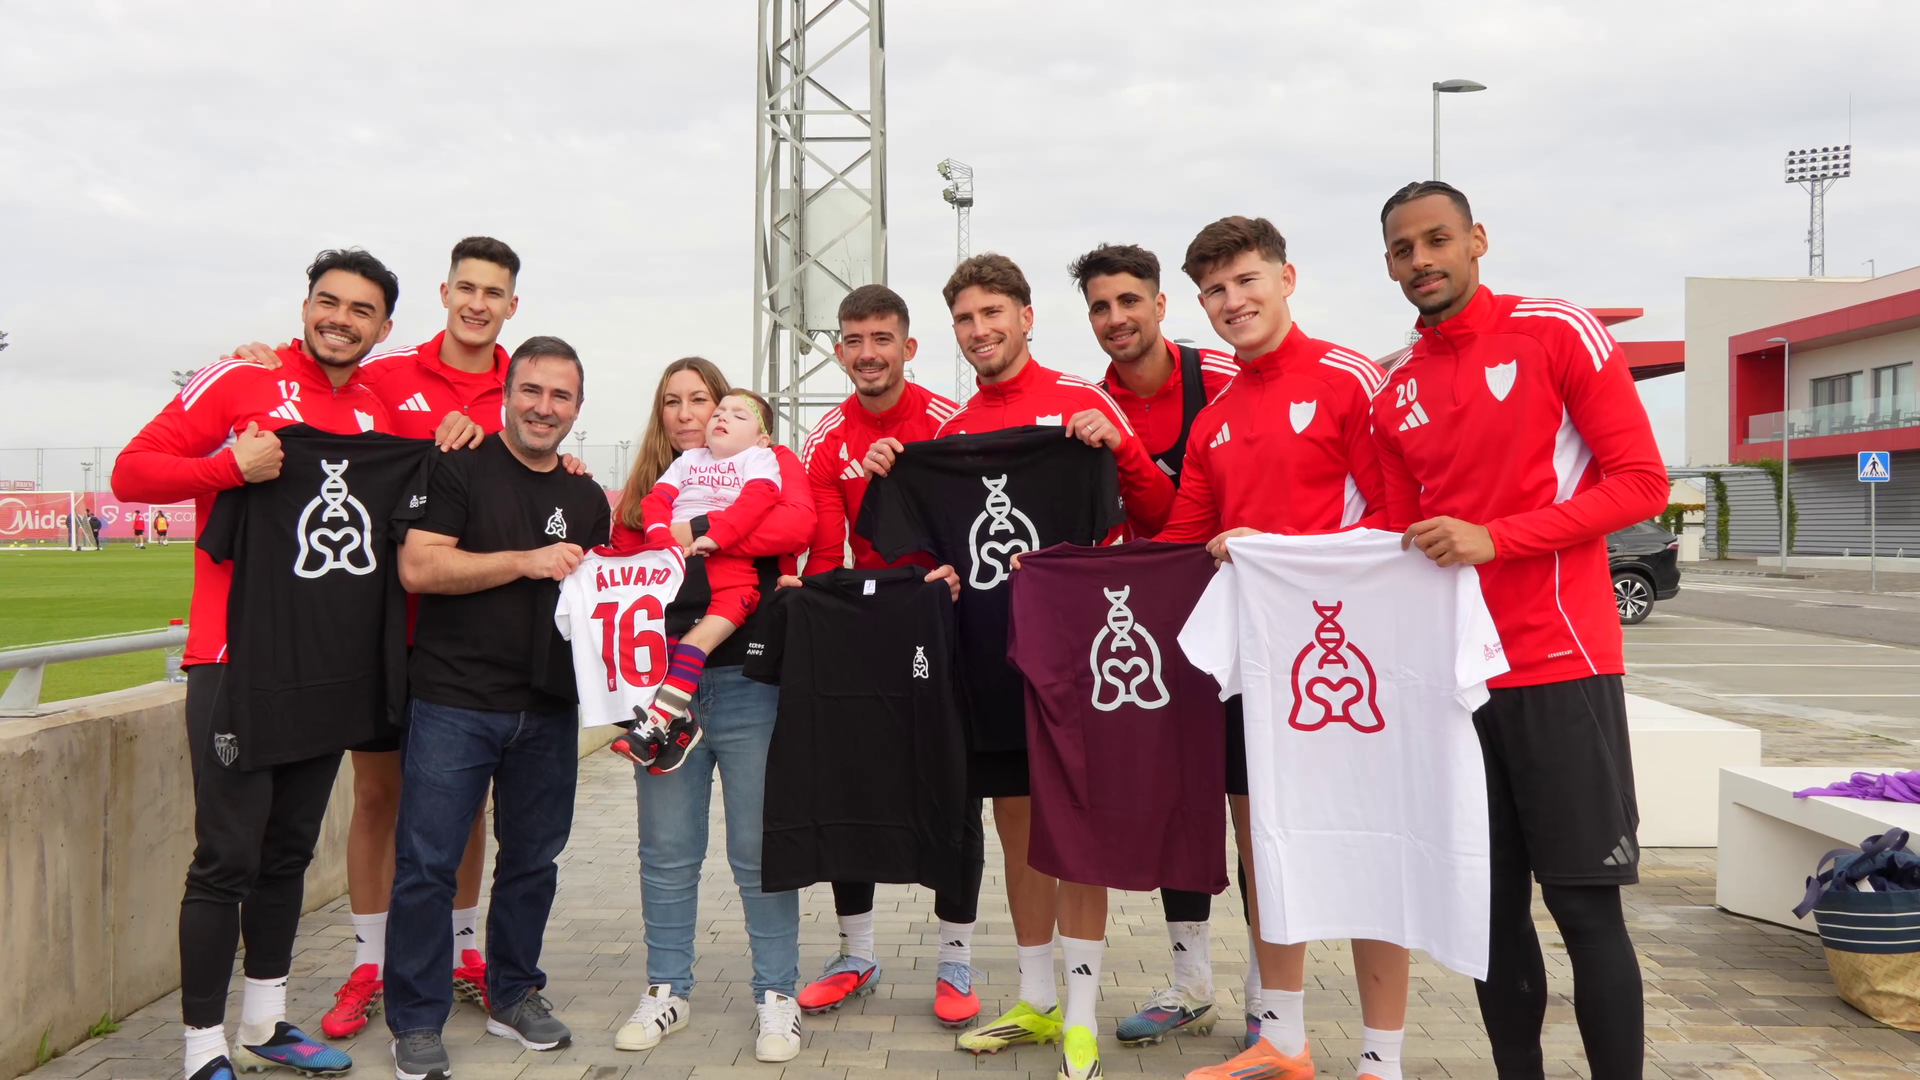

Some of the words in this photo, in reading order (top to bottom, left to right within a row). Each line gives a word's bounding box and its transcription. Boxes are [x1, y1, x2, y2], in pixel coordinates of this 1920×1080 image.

[277, 379, 301, 402] 12
[1396, 377, 1418, 409] 20
[839, 442, 849, 461] 4
[689, 461, 737, 475] NUNCA
[698, 475, 744, 489] RINDA
[7, 510, 69, 530] Mide
[596, 565, 672, 593] ÁLVARO
[591, 594, 668, 692] 16
